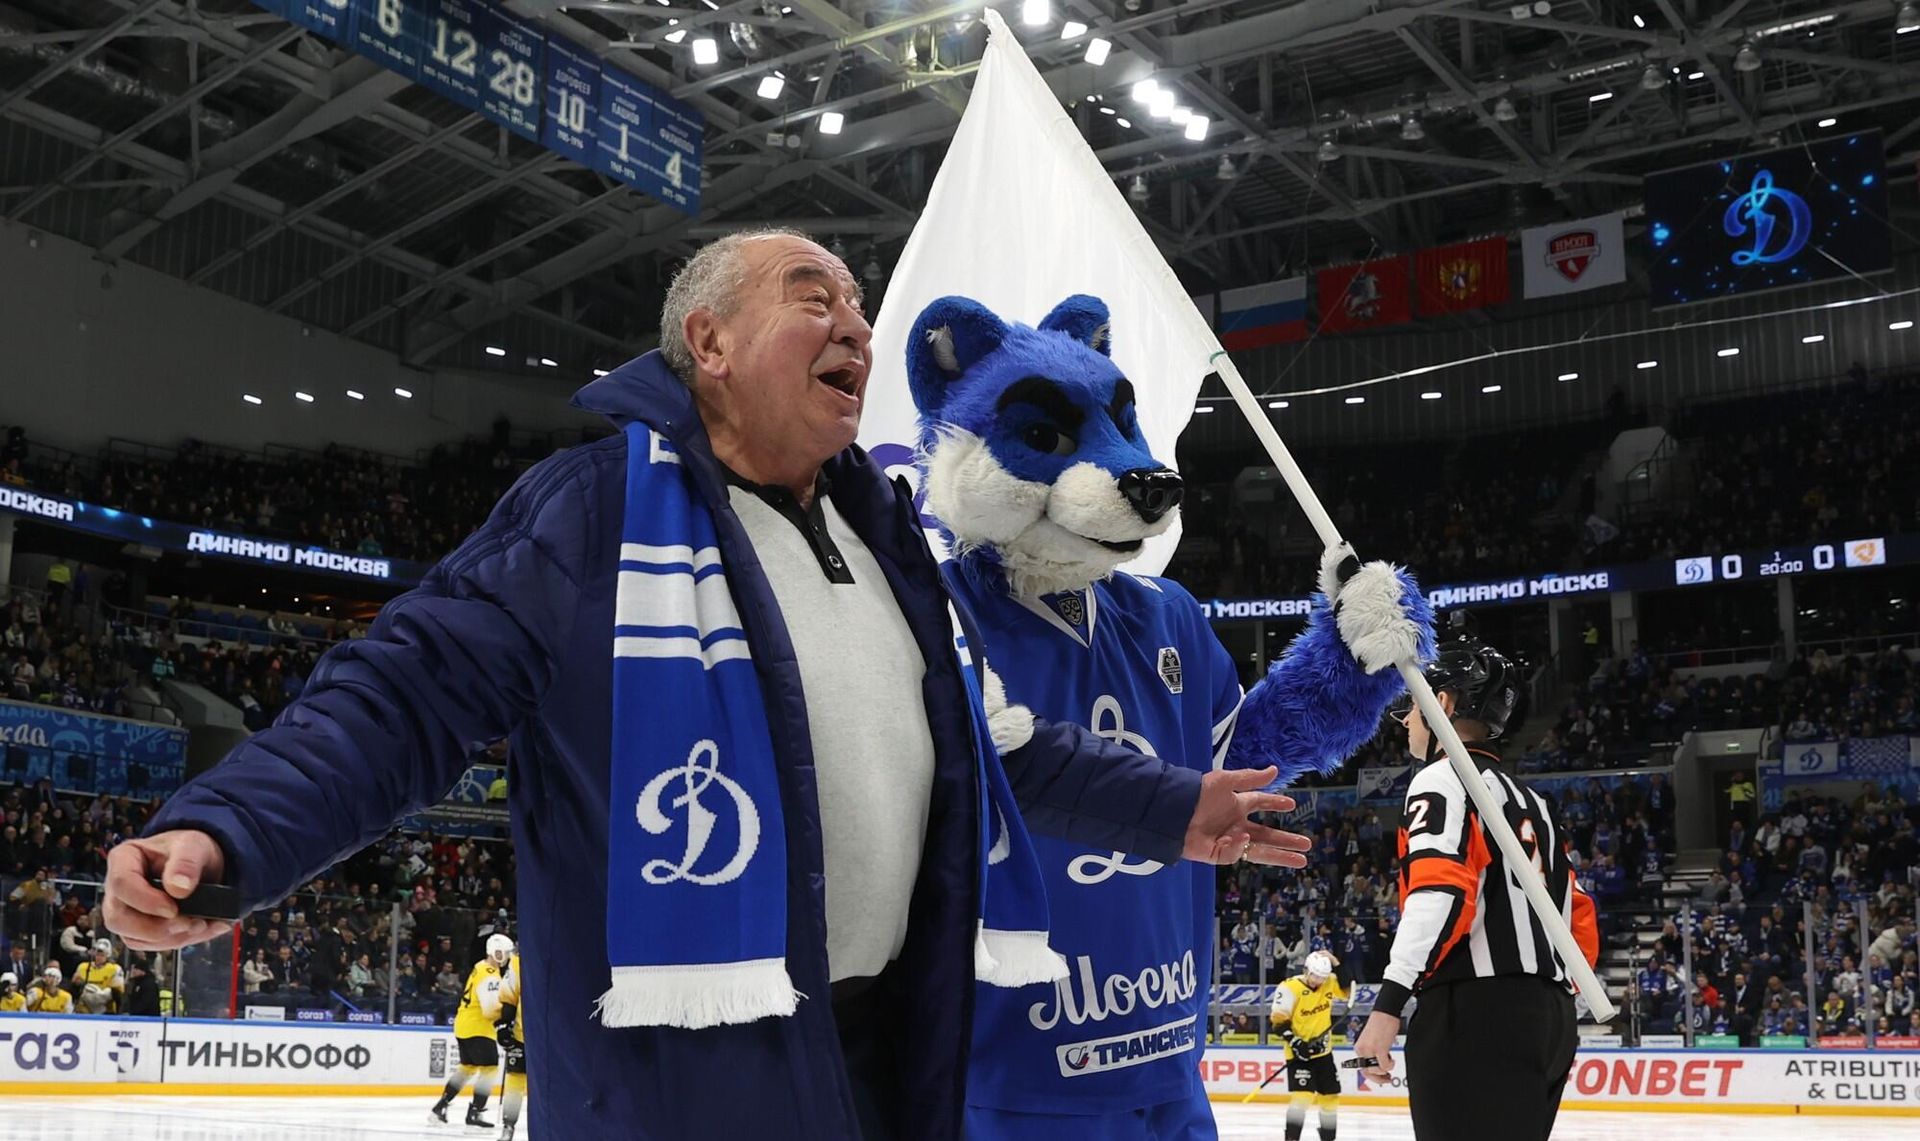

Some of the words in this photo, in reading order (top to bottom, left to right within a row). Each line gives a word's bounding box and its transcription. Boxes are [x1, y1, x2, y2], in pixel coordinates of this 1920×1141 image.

[432, 18, 478, 78] 12
[490, 49, 534, 106] 28
[557, 88, 586, 133] 10
[618, 123, 629, 162] 1
[665, 152, 682, 189] 4
[187, 531, 290, 562] ДИНАМО
[295, 548, 390, 578] МОСКВА
[1721, 555, 1742, 579] 0
[1760, 560, 1803, 575] 20:00
[1773, 551, 1781, 562] 1
[1813, 545, 1834, 570] 0
[1429, 580, 1525, 608] ДИНАМО
[1216, 600, 1312, 618] МОСКВА
[1407, 799, 1430, 833] 2
[1300, 1001, 1330, 1016] Severstal
[158, 1040, 371, 1070] ТИНЬКОФФ
[1808, 1082, 1825, 1099] &
[1835, 1083, 1906, 1101] CLUB
